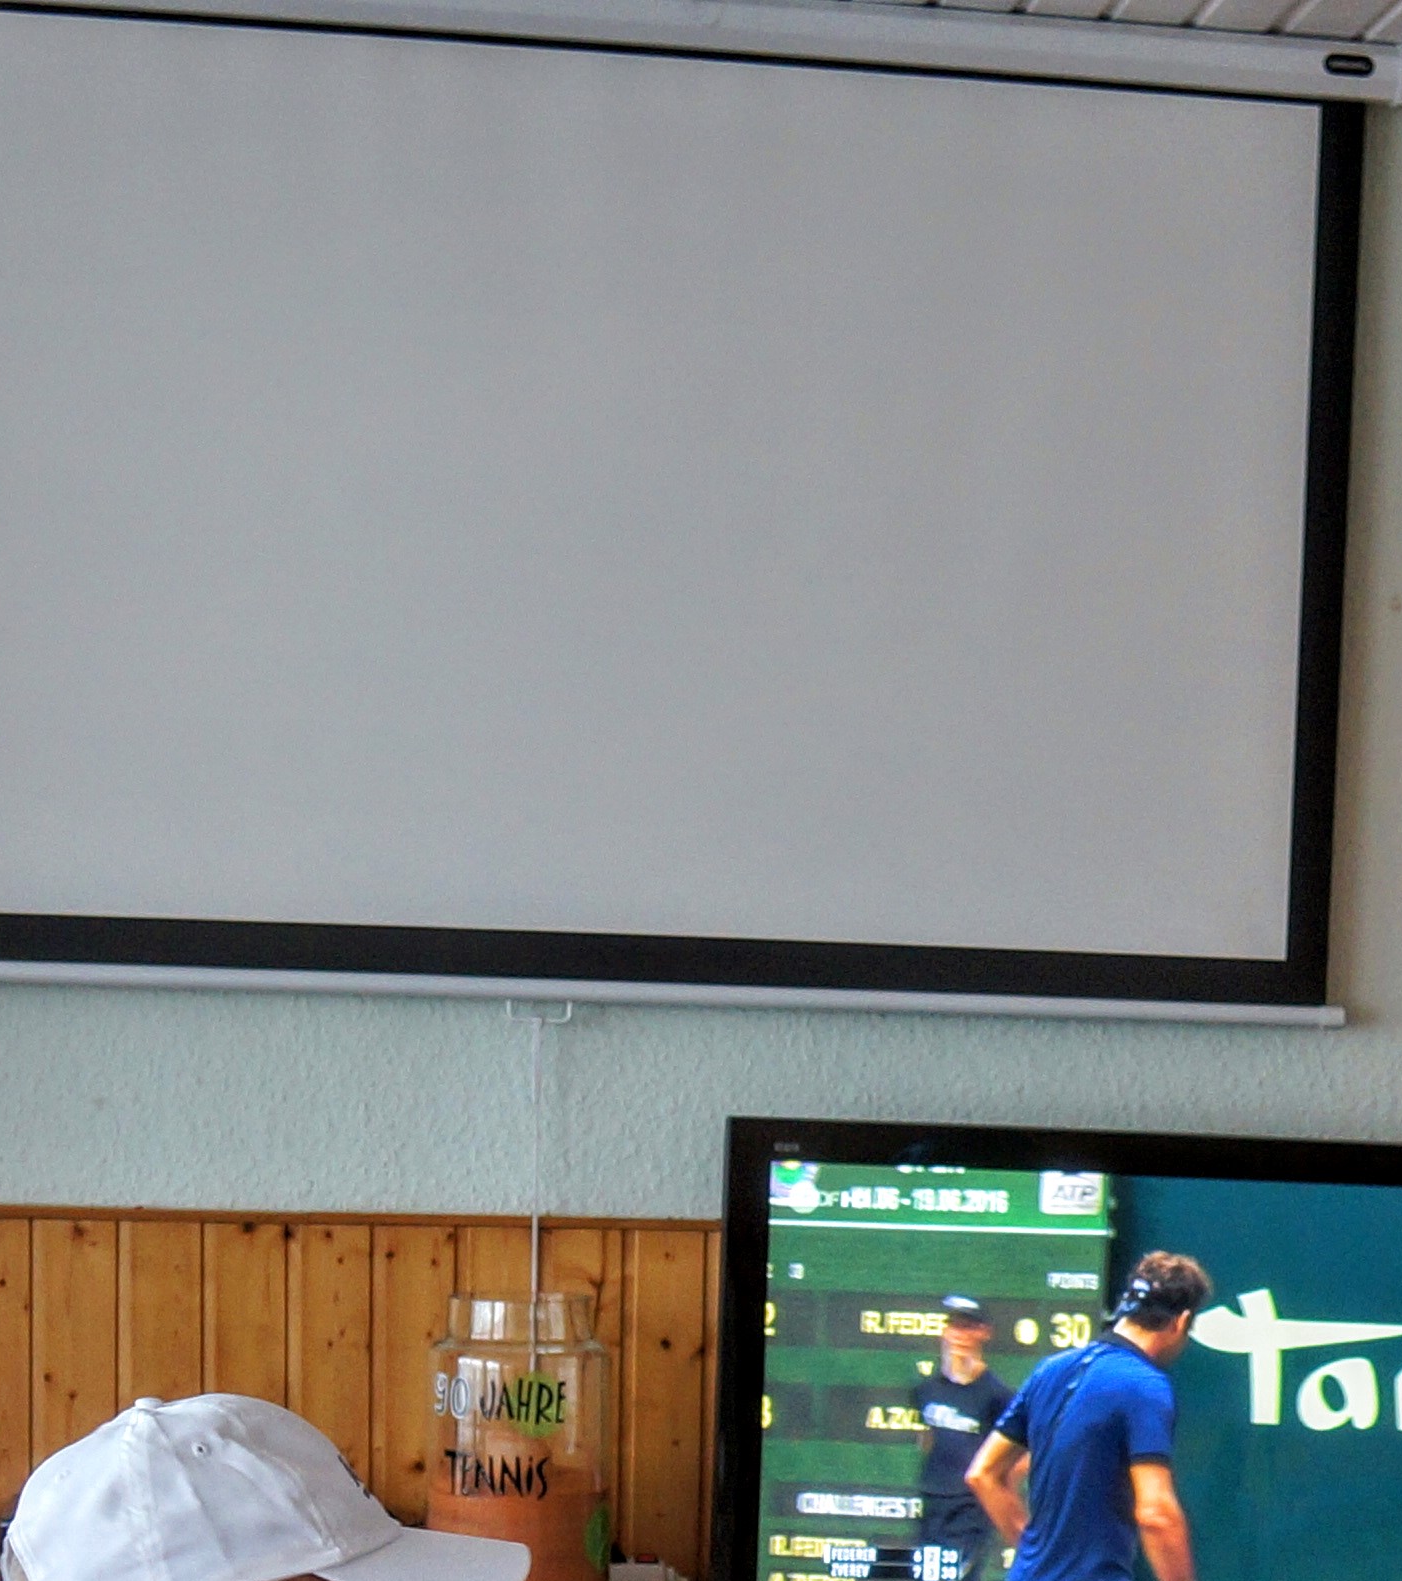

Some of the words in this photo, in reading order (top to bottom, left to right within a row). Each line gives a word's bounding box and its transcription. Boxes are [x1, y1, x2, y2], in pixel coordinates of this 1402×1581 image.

[1050, 1312, 1091, 1348] 30
[480, 1380, 567, 1425] JAHRE
[831, 1547, 877, 1562] FEDERER
[941, 1550, 958, 1564] 30
[831, 1563, 870, 1578] ZVEREV
[941, 1566, 958, 1580] 30
